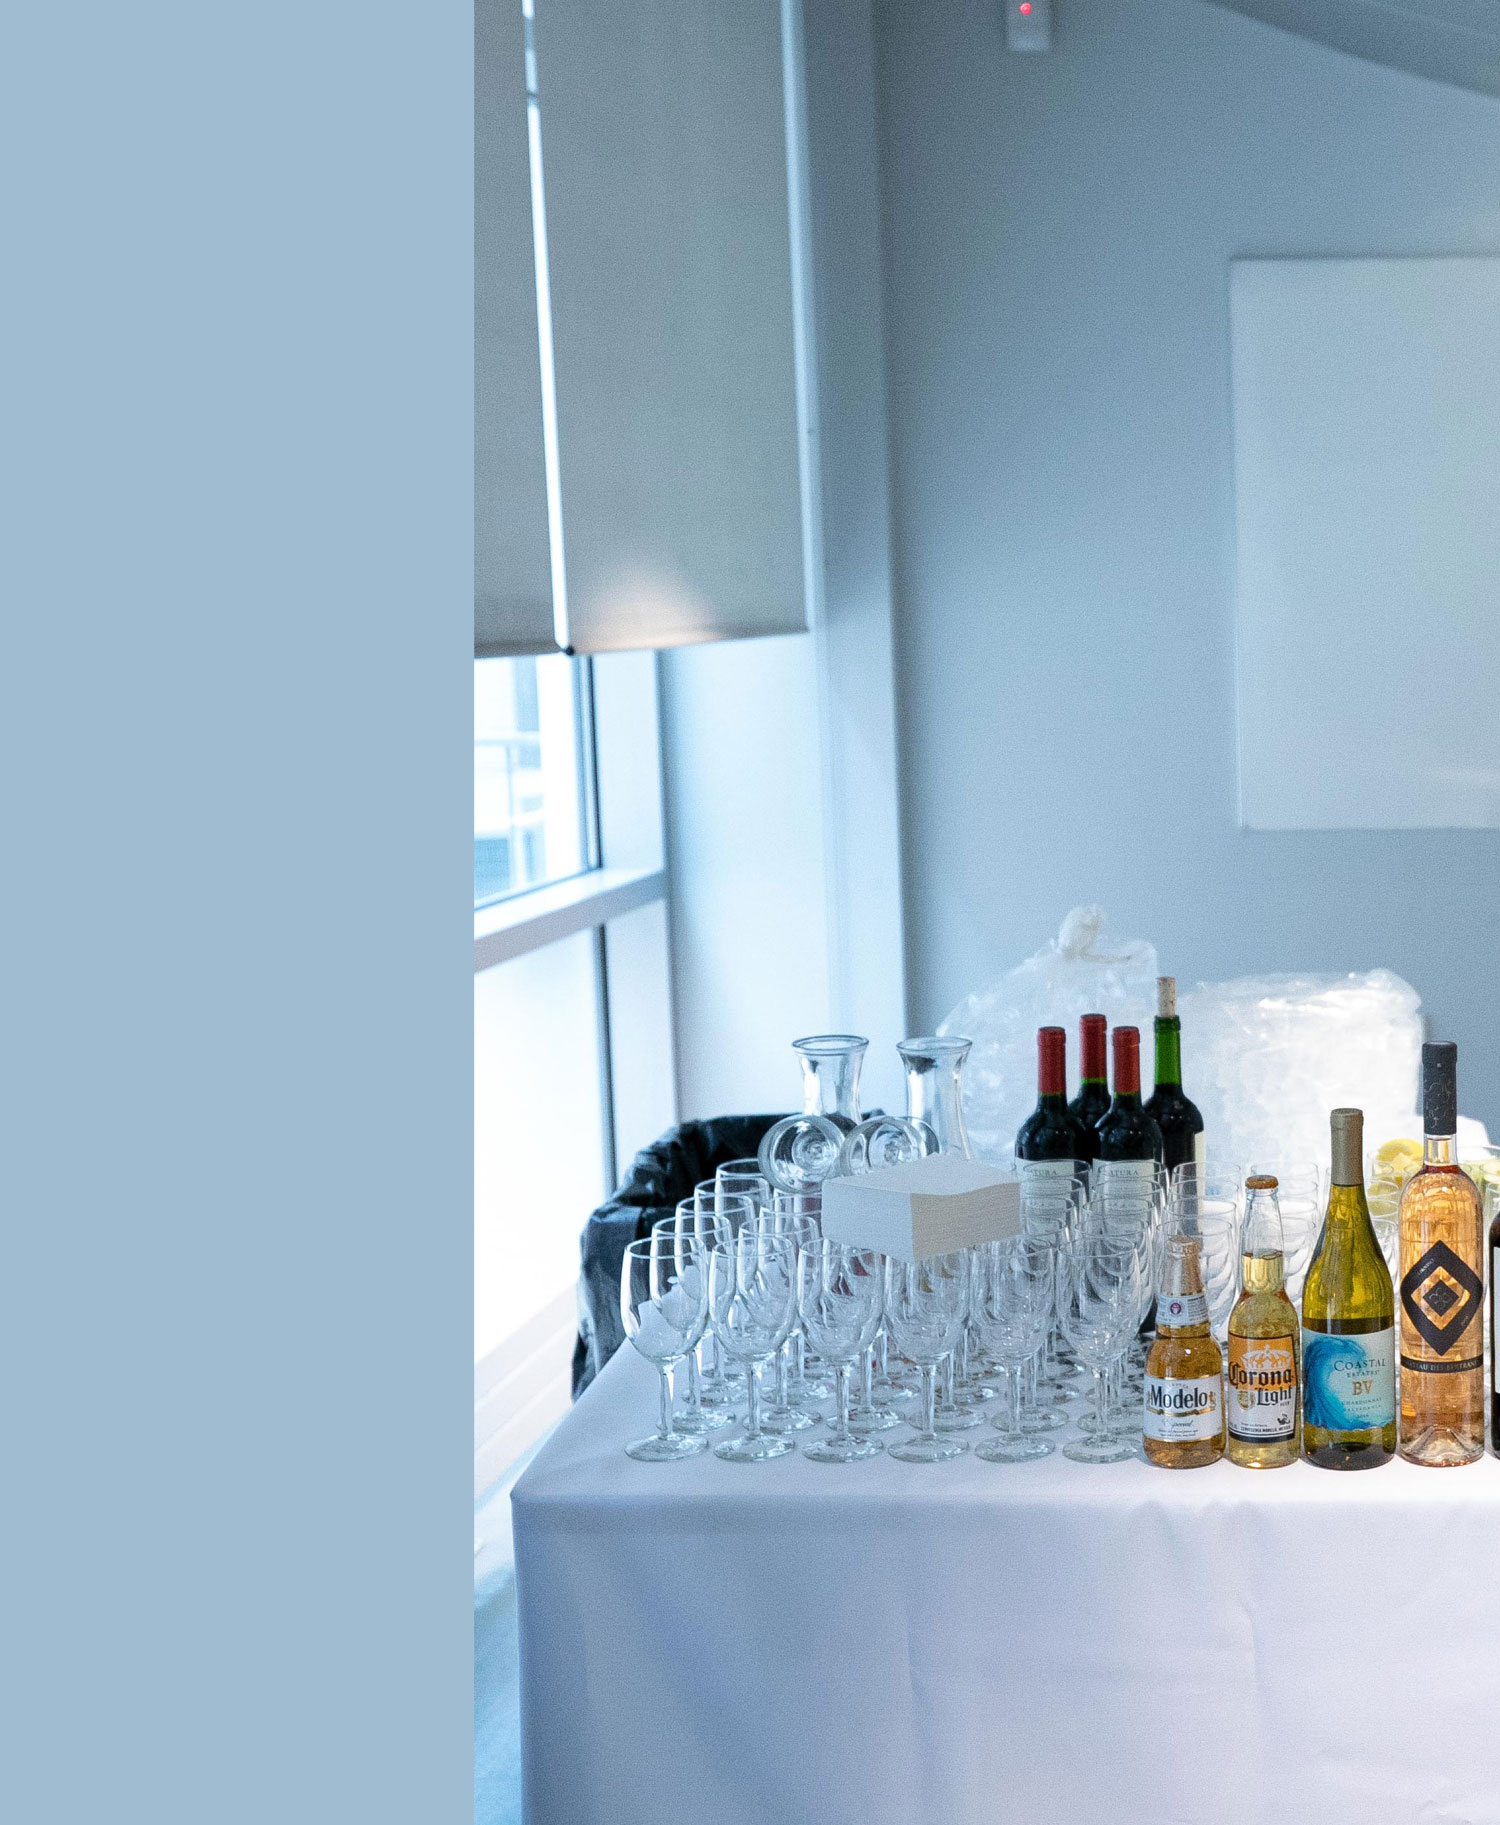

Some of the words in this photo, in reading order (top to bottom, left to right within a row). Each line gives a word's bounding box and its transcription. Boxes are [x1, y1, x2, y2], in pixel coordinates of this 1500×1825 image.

[1229, 1361, 1290, 1390] Corona
[1334, 1358, 1387, 1372] COASTAL
[1150, 1384, 1208, 1409] Modelo
[1255, 1385, 1292, 1406] Light
[1352, 1379, 1374, 1396] BV
